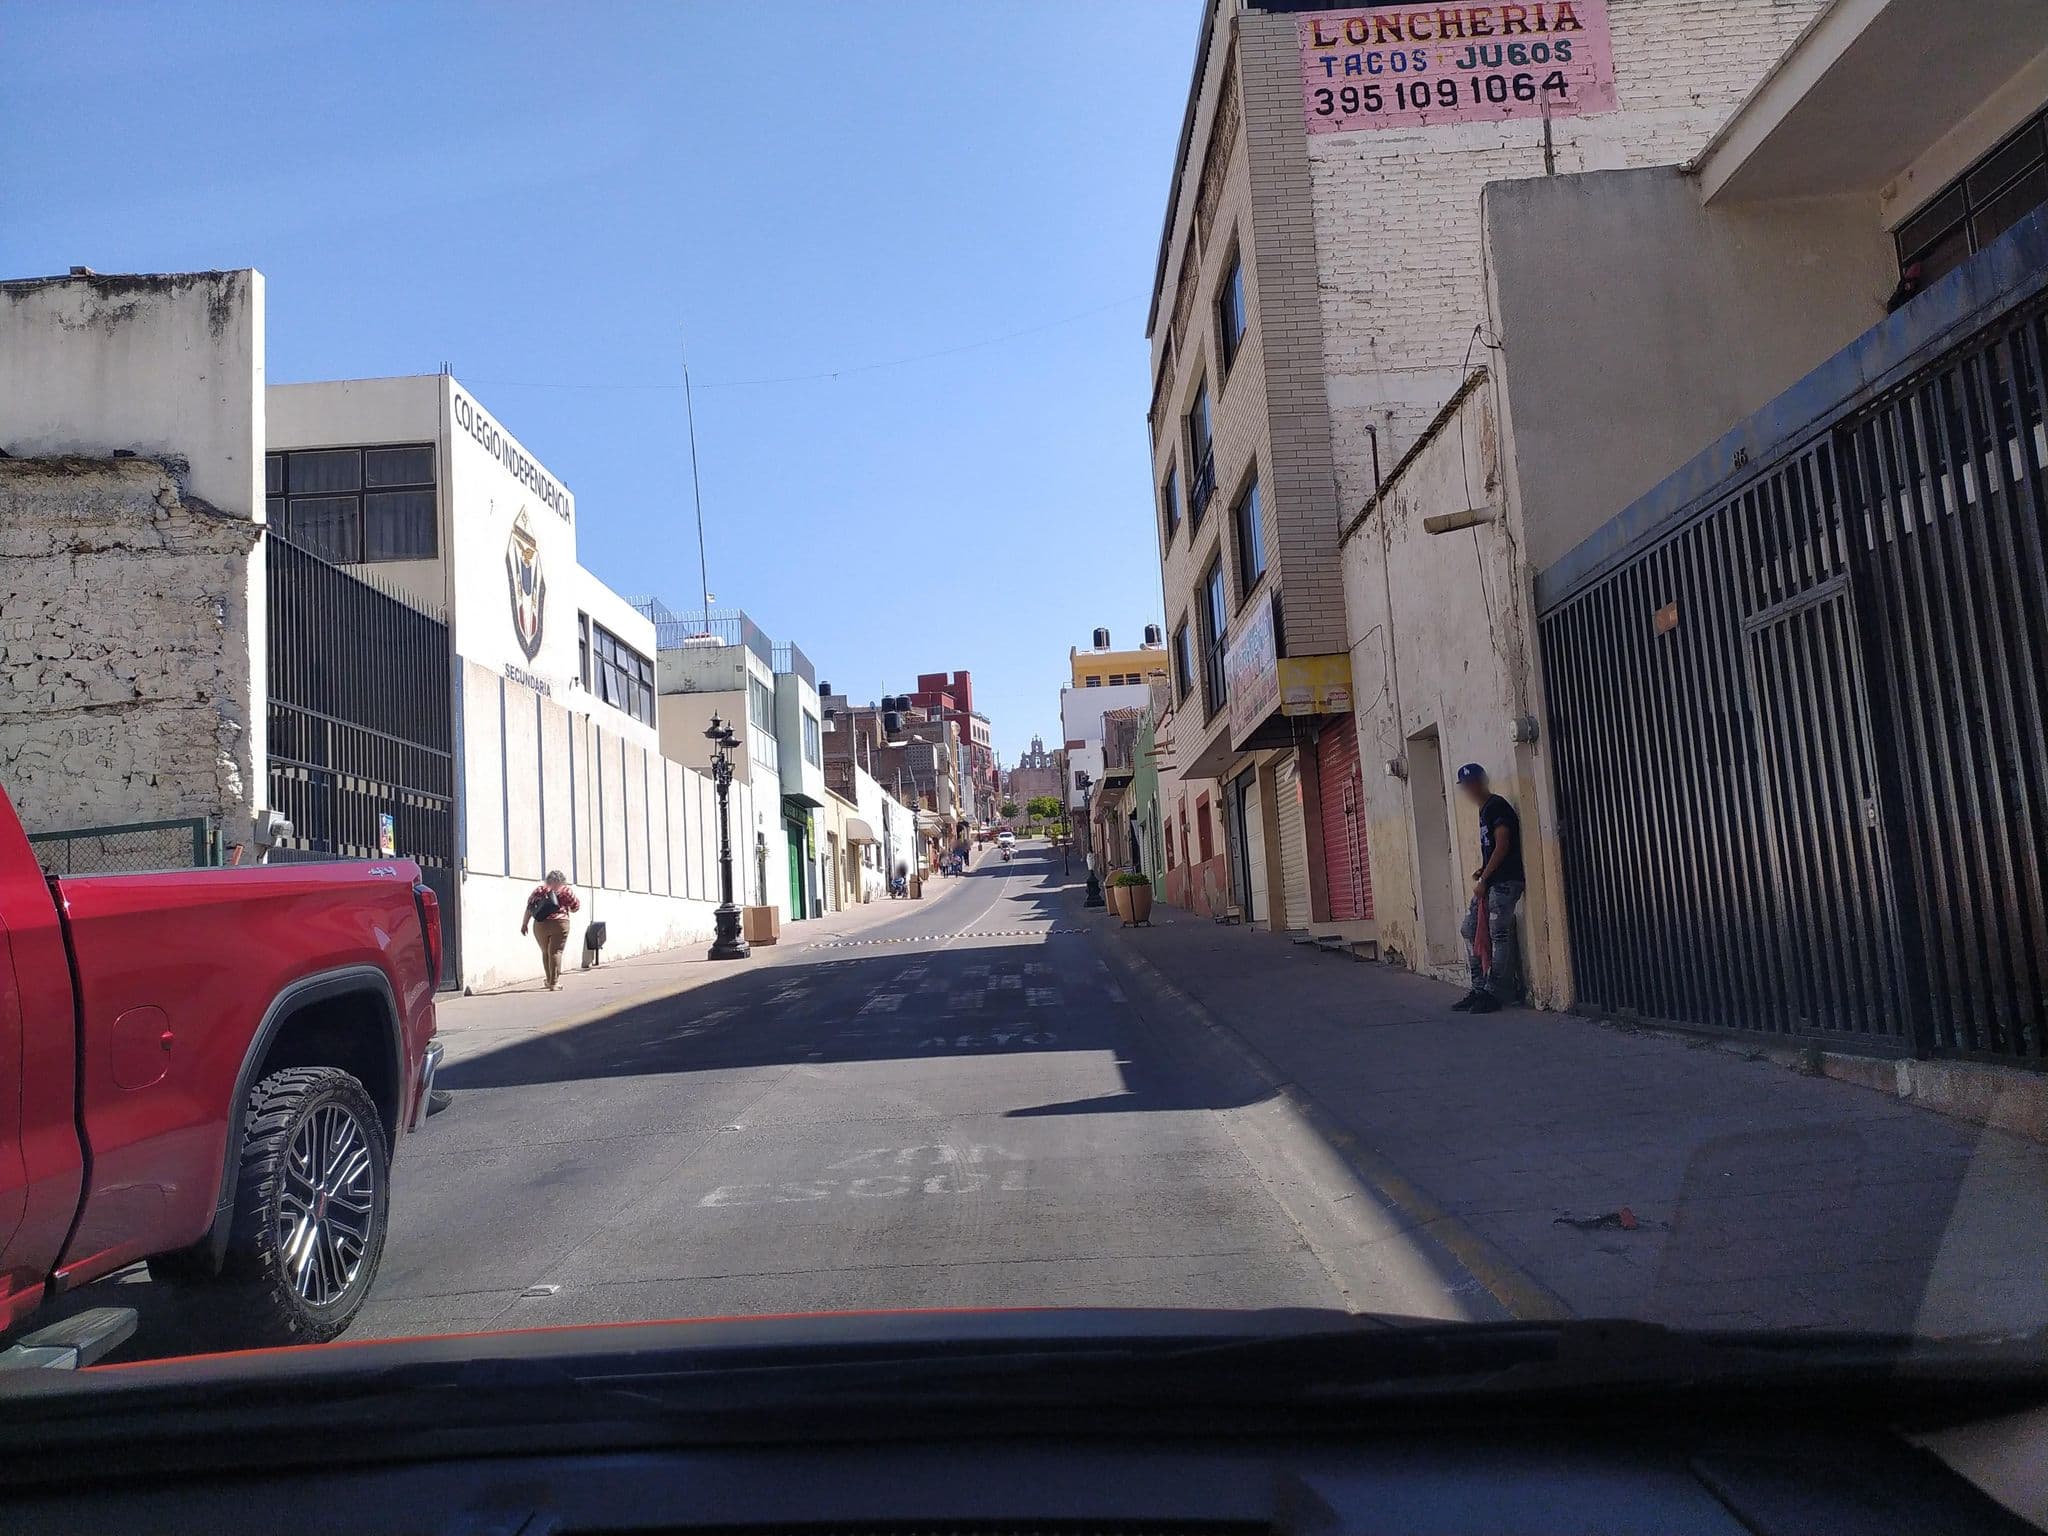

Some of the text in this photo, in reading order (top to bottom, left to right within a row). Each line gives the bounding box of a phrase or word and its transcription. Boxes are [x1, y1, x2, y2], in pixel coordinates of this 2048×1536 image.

[1311, 2, 1584, 48] LONCHERIA
[1319, 49, 1428, 78] TACOS
[1314, 71, 1569, 116] 395 109 1064
[454, 393, 571, 525] COLEGIO INDEPENDENCIA
[505, 662, 552, 699] SECUNDARIA
